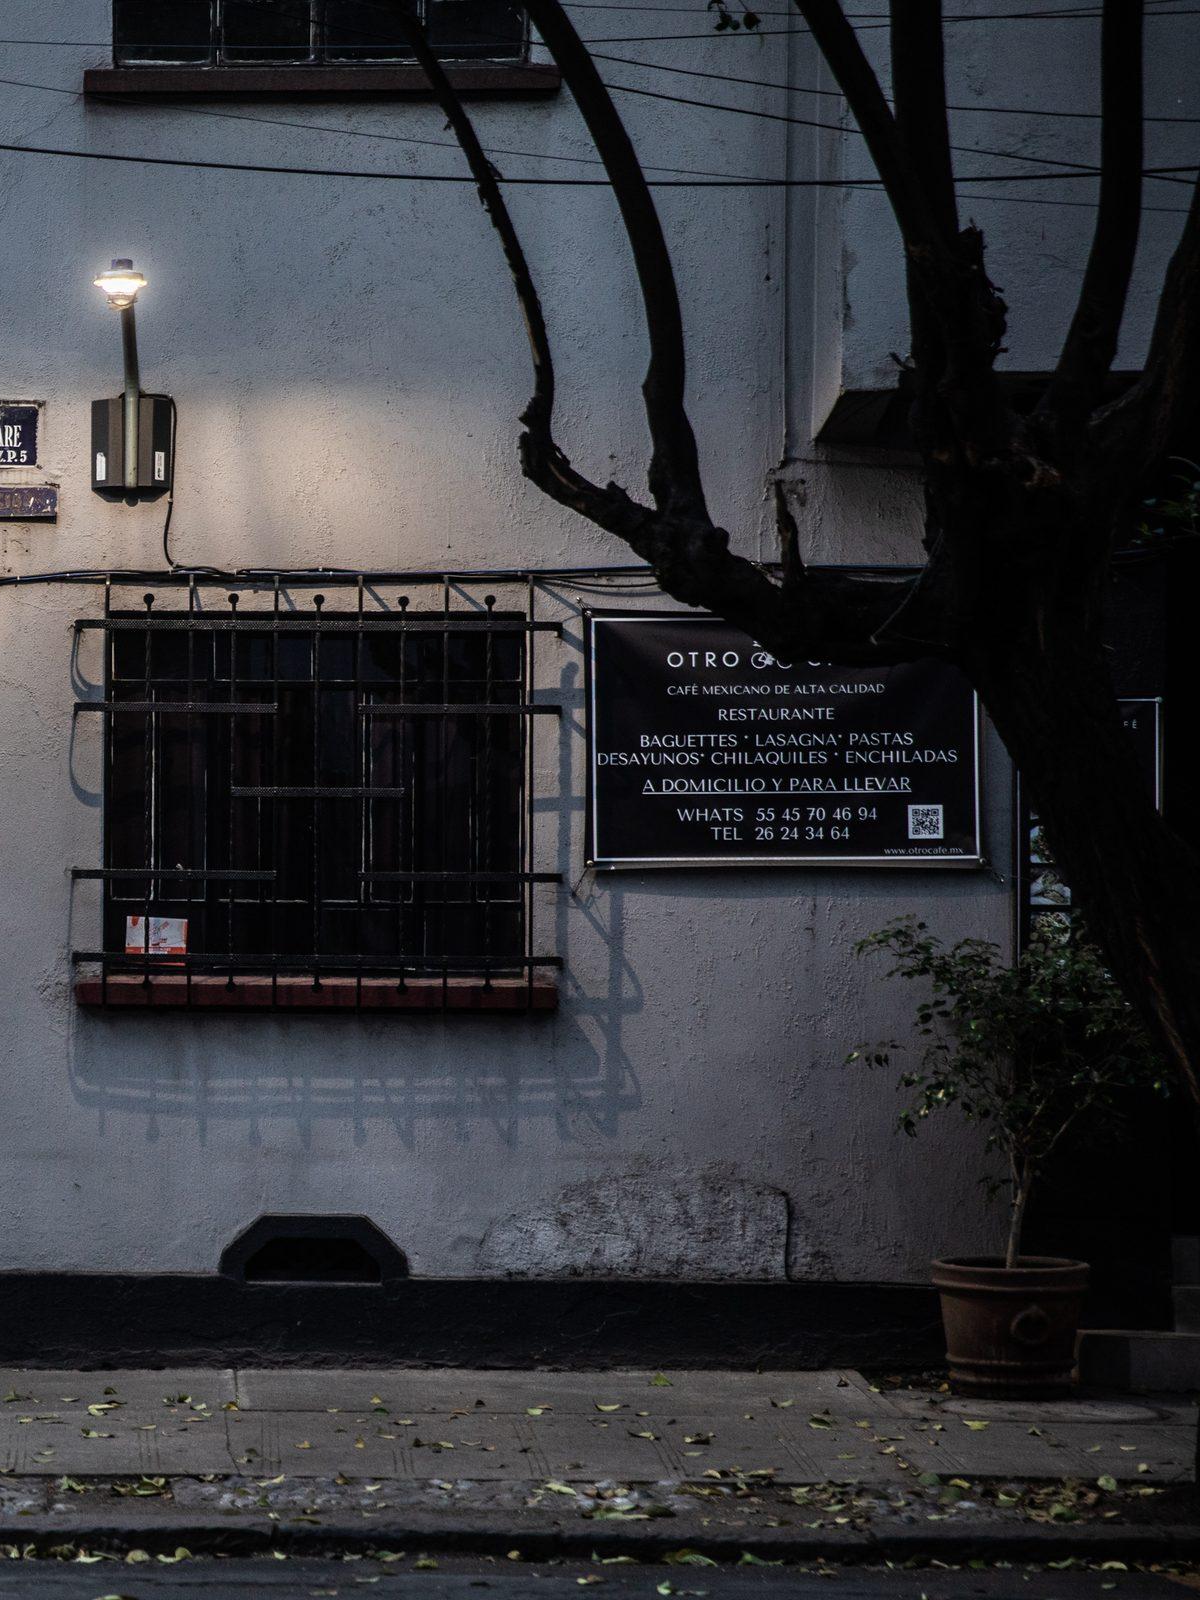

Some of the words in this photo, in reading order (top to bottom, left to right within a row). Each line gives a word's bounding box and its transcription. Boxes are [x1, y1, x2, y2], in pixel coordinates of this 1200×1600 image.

[666, 651, 740, 668] OTRO
[666, 682, 699, 696] CAFÉ
[702, 684, 771, 696] MEXICANO
[774, 684, 790, 695] DE
[794, 683, 826, 695] ALTA
[828, 683, 886, 694] CALIDAD
[717, 707, 836, 721] RESTAURANTE
[639, 734, 738, 748] BAGUETTES
[849, 732, 914, 746] PASTAS
[711, 751, 828, 766] CHILAQUILES
[845, 750, 958, 764] ENCHILADAS
[642, 778, 656, 792] A
[662, 778, 766, 792] DOMICILIO
[771, 778, 783, 792] Y
[789, 778, 837, 791] PARA
[844, 776, 912, 791] LLEVAR
[676, 808, 744, 822] WHATS
[755, 807, 776, 821] 55
[781, 807, 801, 821] 45
[806, 807, 826, 821] 70
[831, 807, 852, 821] 46
[857, 807, 878, 821] 94
[710, 827, 743, 841] TEL
[754, 827, 774, 841] 26
[780, 827, 799, 841] 24
[805, 827, 824, 840] 34
[830, 827, 850, 840] 64
[883, 846, 964, 855] www.otrocafe.mx
